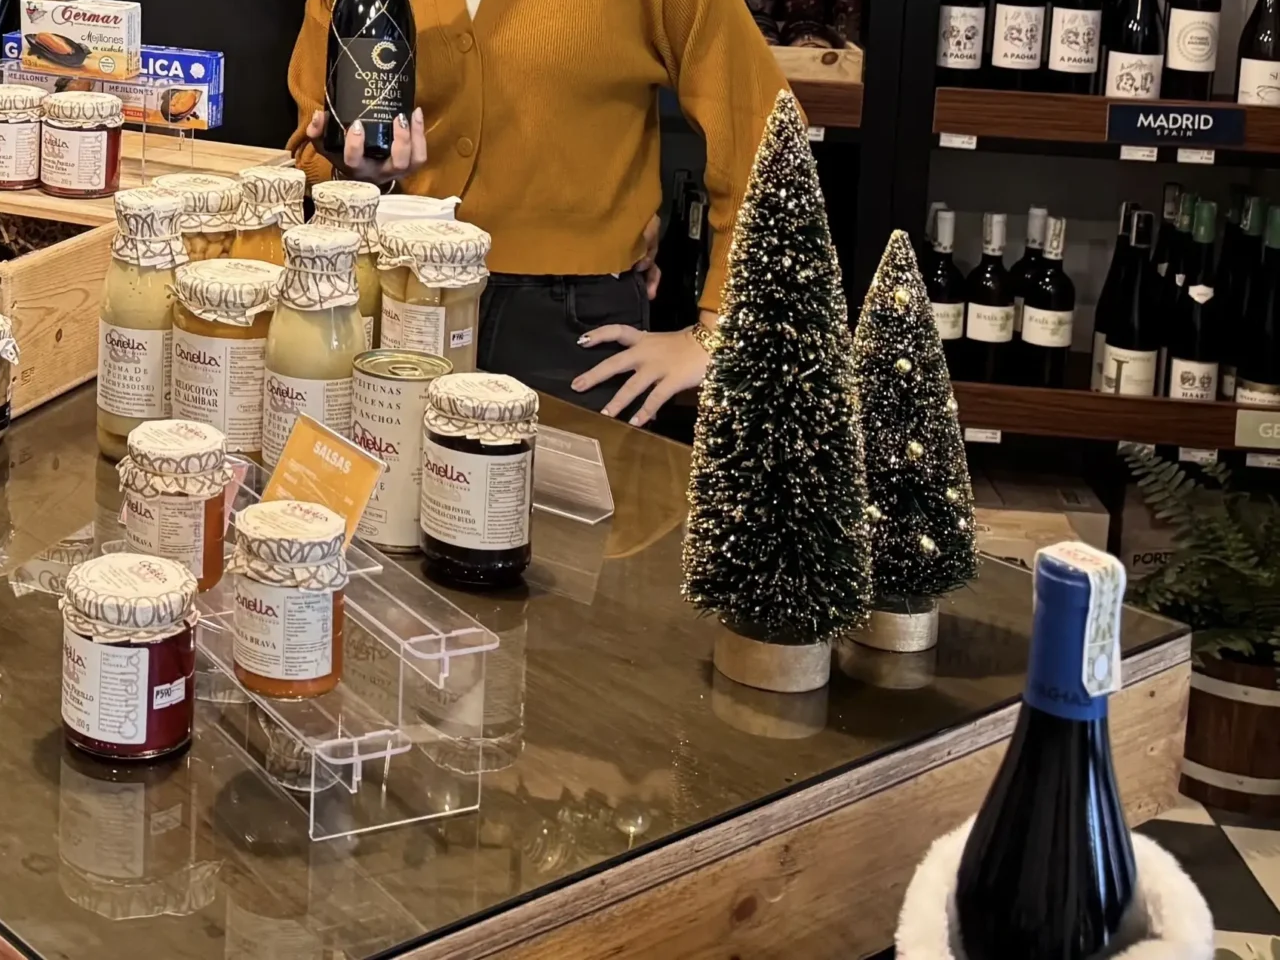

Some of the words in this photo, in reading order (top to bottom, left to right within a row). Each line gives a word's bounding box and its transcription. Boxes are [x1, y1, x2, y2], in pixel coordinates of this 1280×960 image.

[81, 31, 124, 45] Mejillones
[140, 58, 184, 77] LICA
[355, 71, 408, 82] CORNELIO
[369, 80, 399, 89] GRAN
[109, 85, 154, 96] MEJILLONES
[364, 88, 402, 99] DUQUE
[1137, 113, 1213, 130] MADRID
[105, 333, 147, 351] Canella
[175, 343, 220, 367] Canella
[103, 360, 129, 374] CREMA
[134, 367, 148, 375] DE
[107, 370, 141, 383] PUERRO
[175, 378, 218, 397] MELOCOTÓN
[267, 379, 306, 401] Canella
[182, 391, 218, 408] ALMÍBAR
[360, 409, 401, 426] ANCHOA
[313, 441, 352, 474] SALSAS
[250, 635, 276, 650] BRAVA
